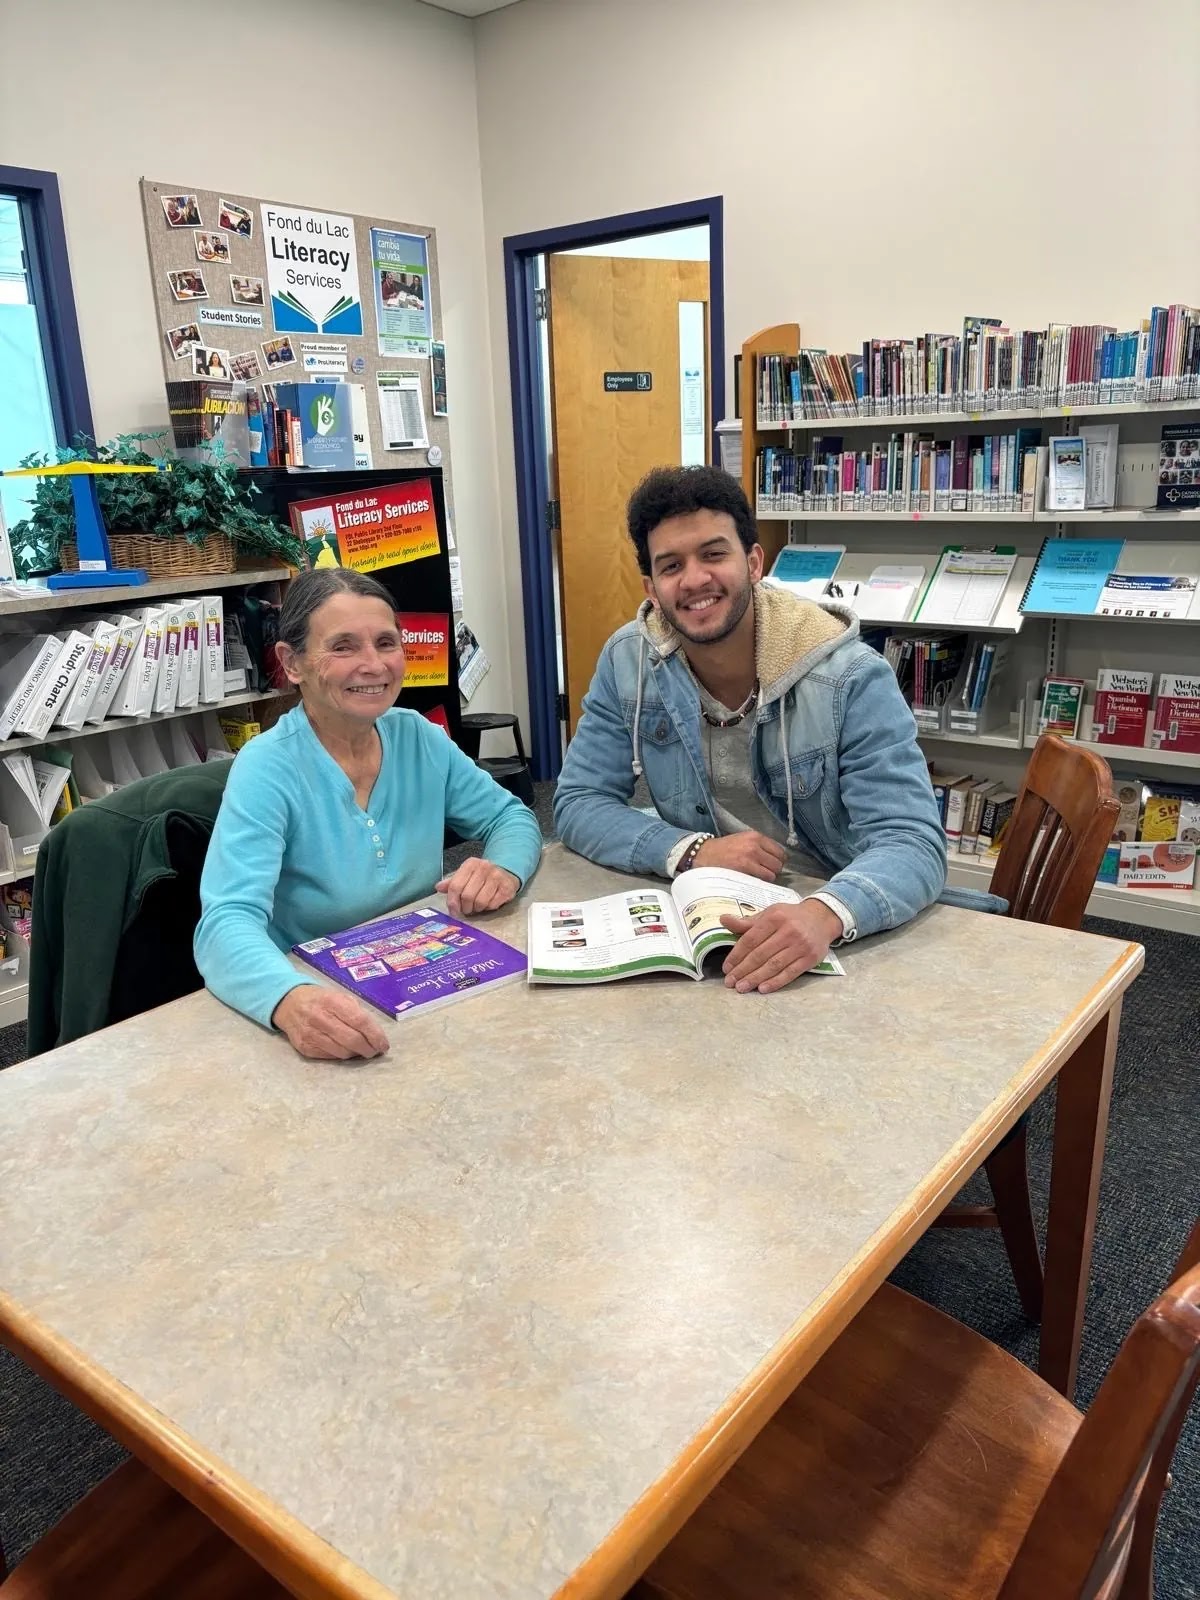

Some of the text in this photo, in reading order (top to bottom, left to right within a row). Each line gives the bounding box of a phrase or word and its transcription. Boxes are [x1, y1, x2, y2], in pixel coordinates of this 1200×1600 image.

[267, 211, 349, 239] Fond du Lac
[271, 236, 350, 273] Literacy
[286, 268, 342, 290] Services
[201, 310, 261, 326] Student Stories
[317, 358, 346, 367] ProLiteracy
[336, 497, 378, 513] Fond du Lac
[337, 499, 430, 529] Literacy Services
[386, 547, 401, 560] read
[402, 545, 419, 558] opens
[208, 629, 217, 650] BLUE
[402, 629, 444, 643] Services
[143, 631, 157, 685] PURPLE LEVEL
[80, 646, 105, 698] ORANGE LEVEL
[101, 645, 127, 696] YELLOW LEVEL
[165, 642, 176, 692] GREEN LEVEL
[45, 643, 86, 709] Study Charts
[1111, 674, 1149, 686] Webster's
[8, 651, 54, 726] BANKING AND CREDIT
[1110, 682, 1148, 693] New World
[1172, 688, 1189, 697] New
[1107, 693, 1137, 705] Spanish
[1106, 702, 1145, 714] Dictionary
[1144, 873, 1167, 881] EDITS
[447, 968, 467, 981] At
[467, 959, 505, 975] Wild
[407, 975, 452, 994] Heart
